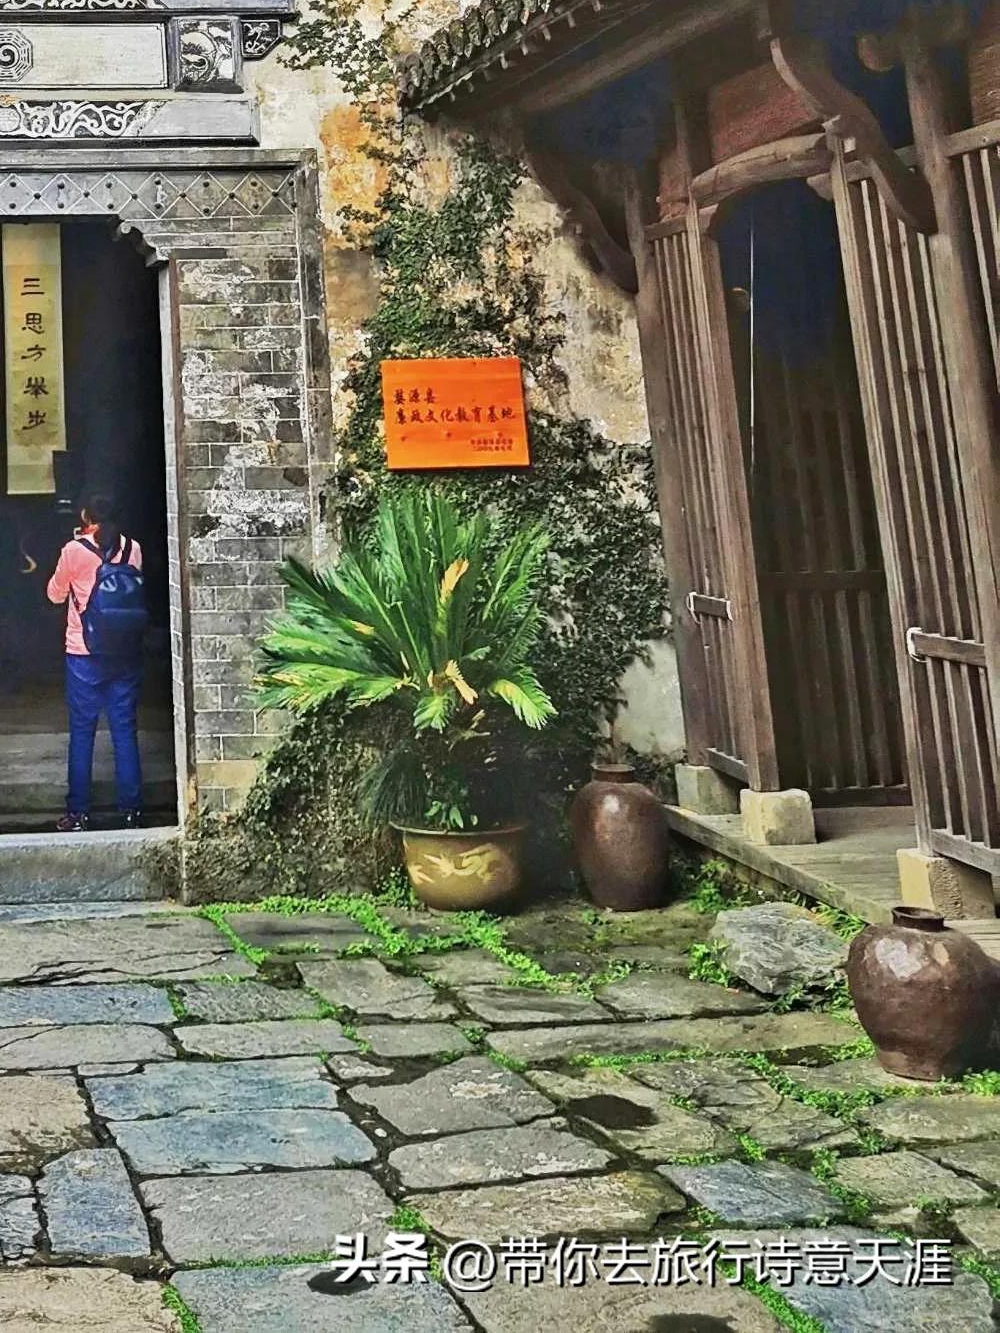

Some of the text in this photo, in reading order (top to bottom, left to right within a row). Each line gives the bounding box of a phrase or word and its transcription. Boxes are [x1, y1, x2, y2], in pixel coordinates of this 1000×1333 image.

[393, 387, 436, 405] 婺源县
[395, 406, 516, 425] 廉政文化教育基地
